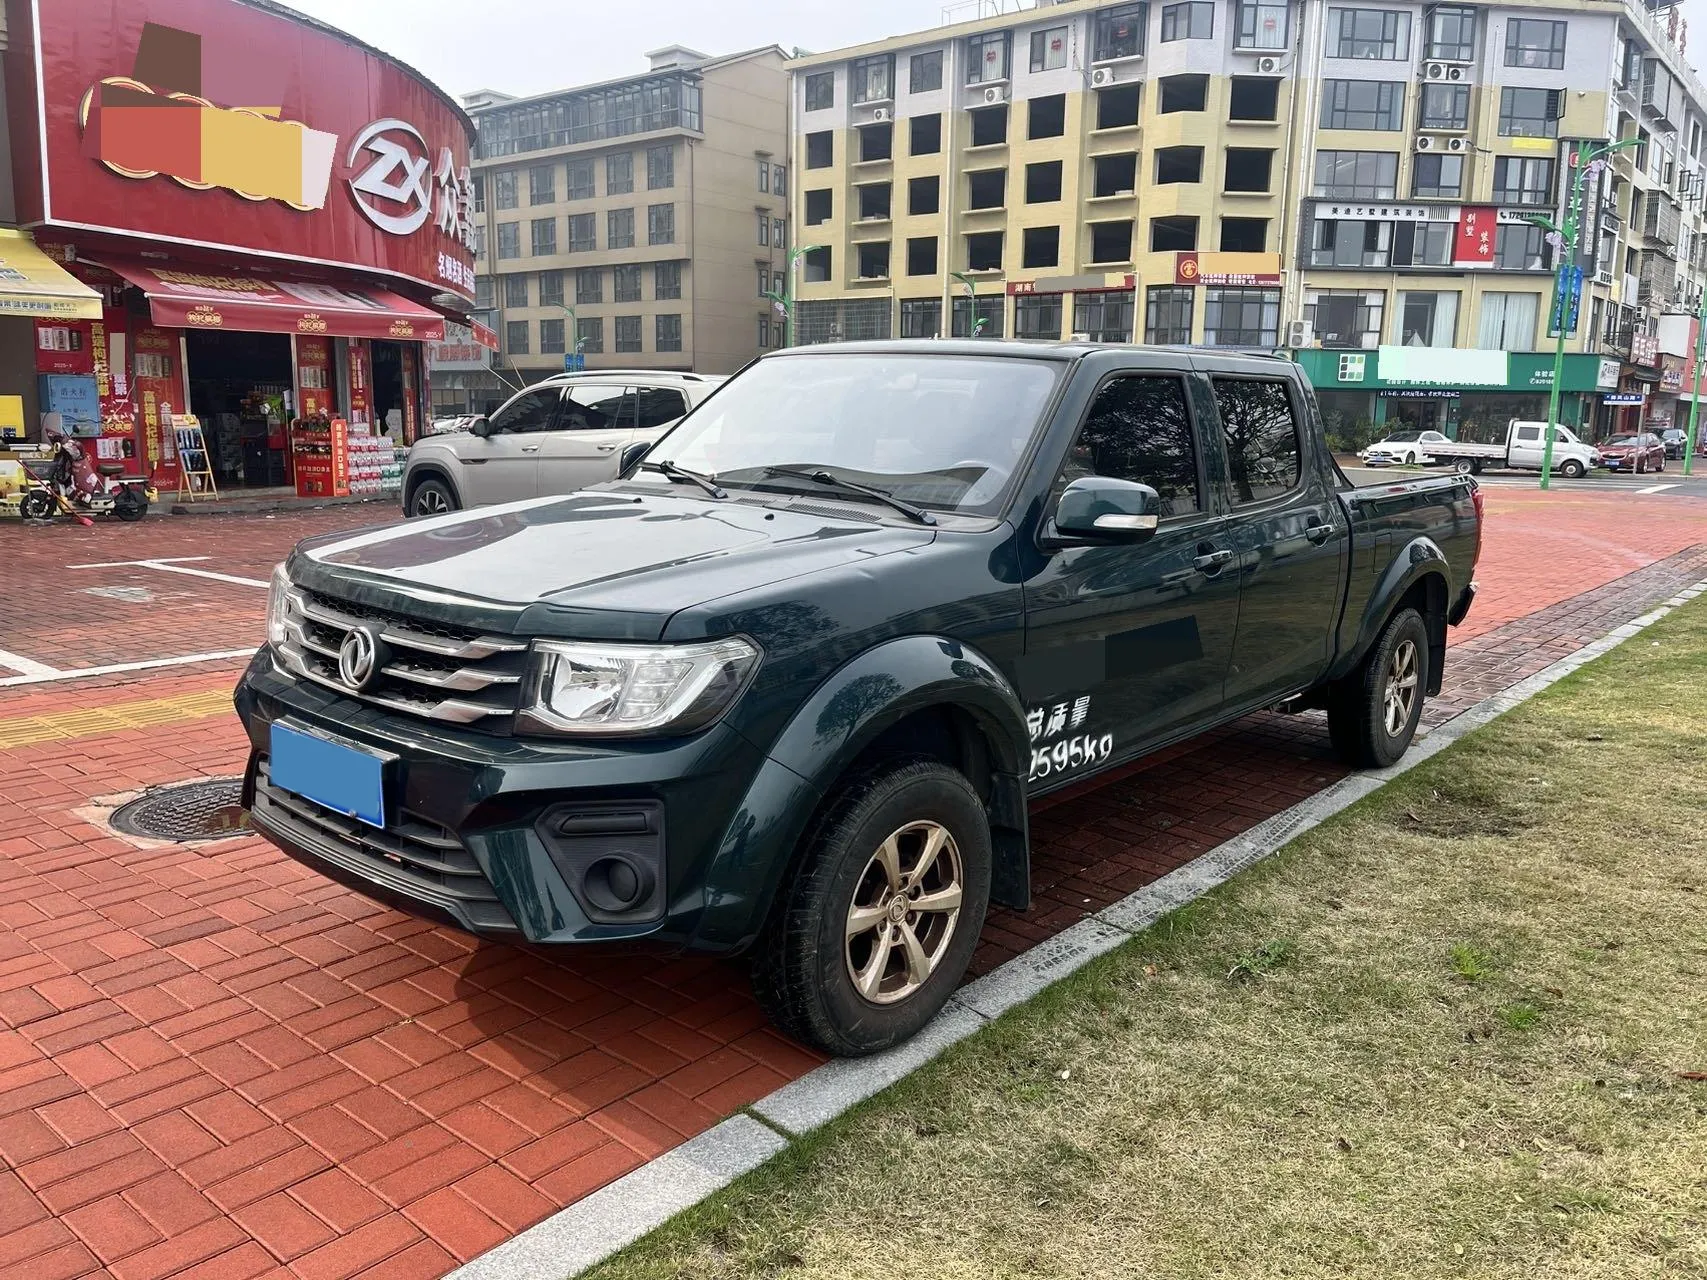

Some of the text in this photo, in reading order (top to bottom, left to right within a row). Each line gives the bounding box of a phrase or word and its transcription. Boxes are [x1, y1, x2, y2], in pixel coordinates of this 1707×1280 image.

[1465, 212, 1477, 238] 别墅
[1026, 695, 1091, 742] 总质量
